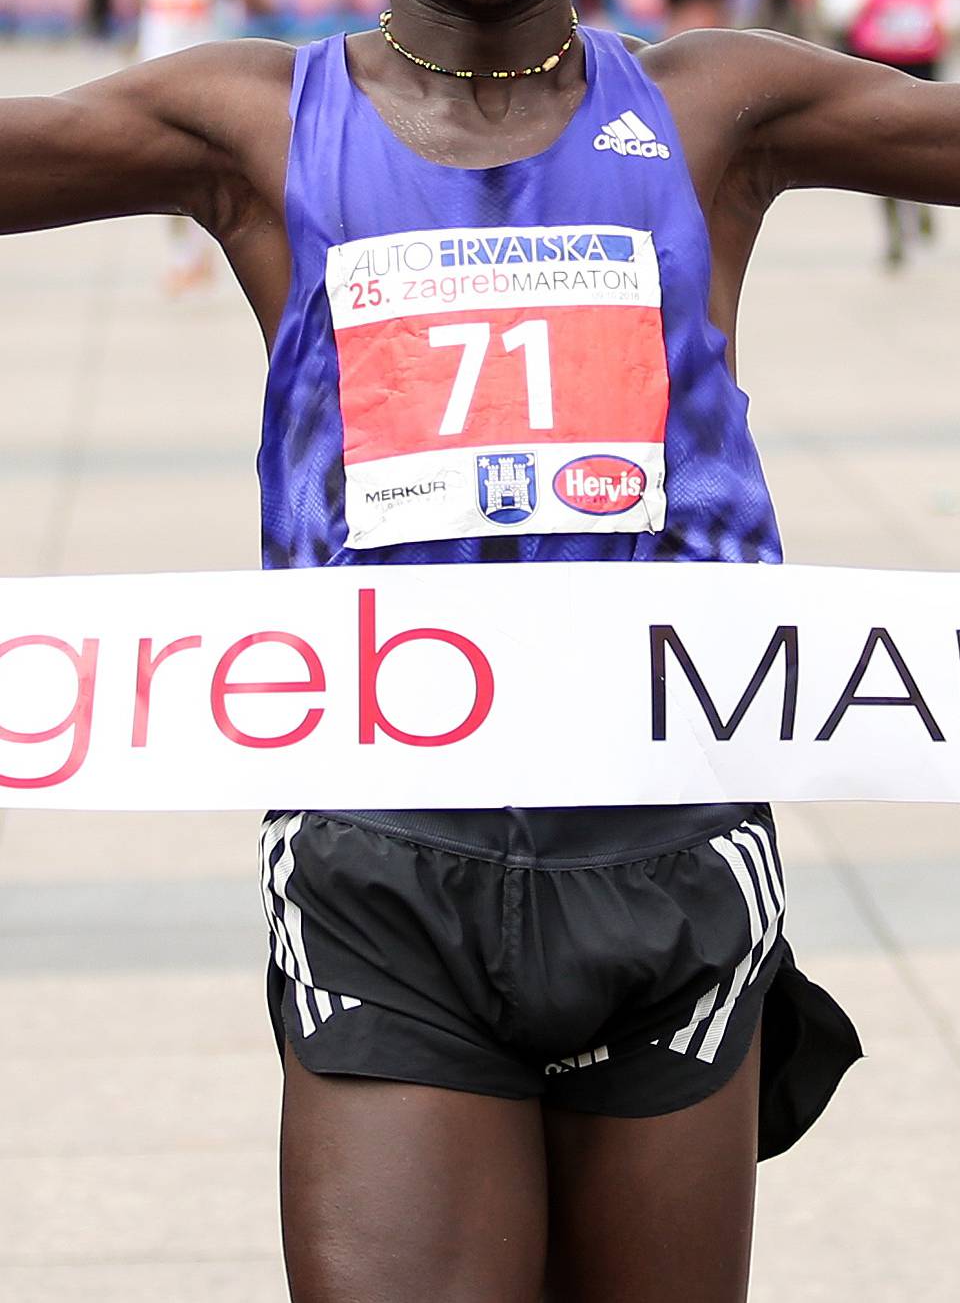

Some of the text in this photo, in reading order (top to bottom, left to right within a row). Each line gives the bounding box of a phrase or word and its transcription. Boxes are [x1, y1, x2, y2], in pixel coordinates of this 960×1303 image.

[350, 242, 433, 281] AUTO
[350, 280, 390, 309] 25.
[428, 319, 553, 436] 71
[365, 481, 446, 503] MERKUR
